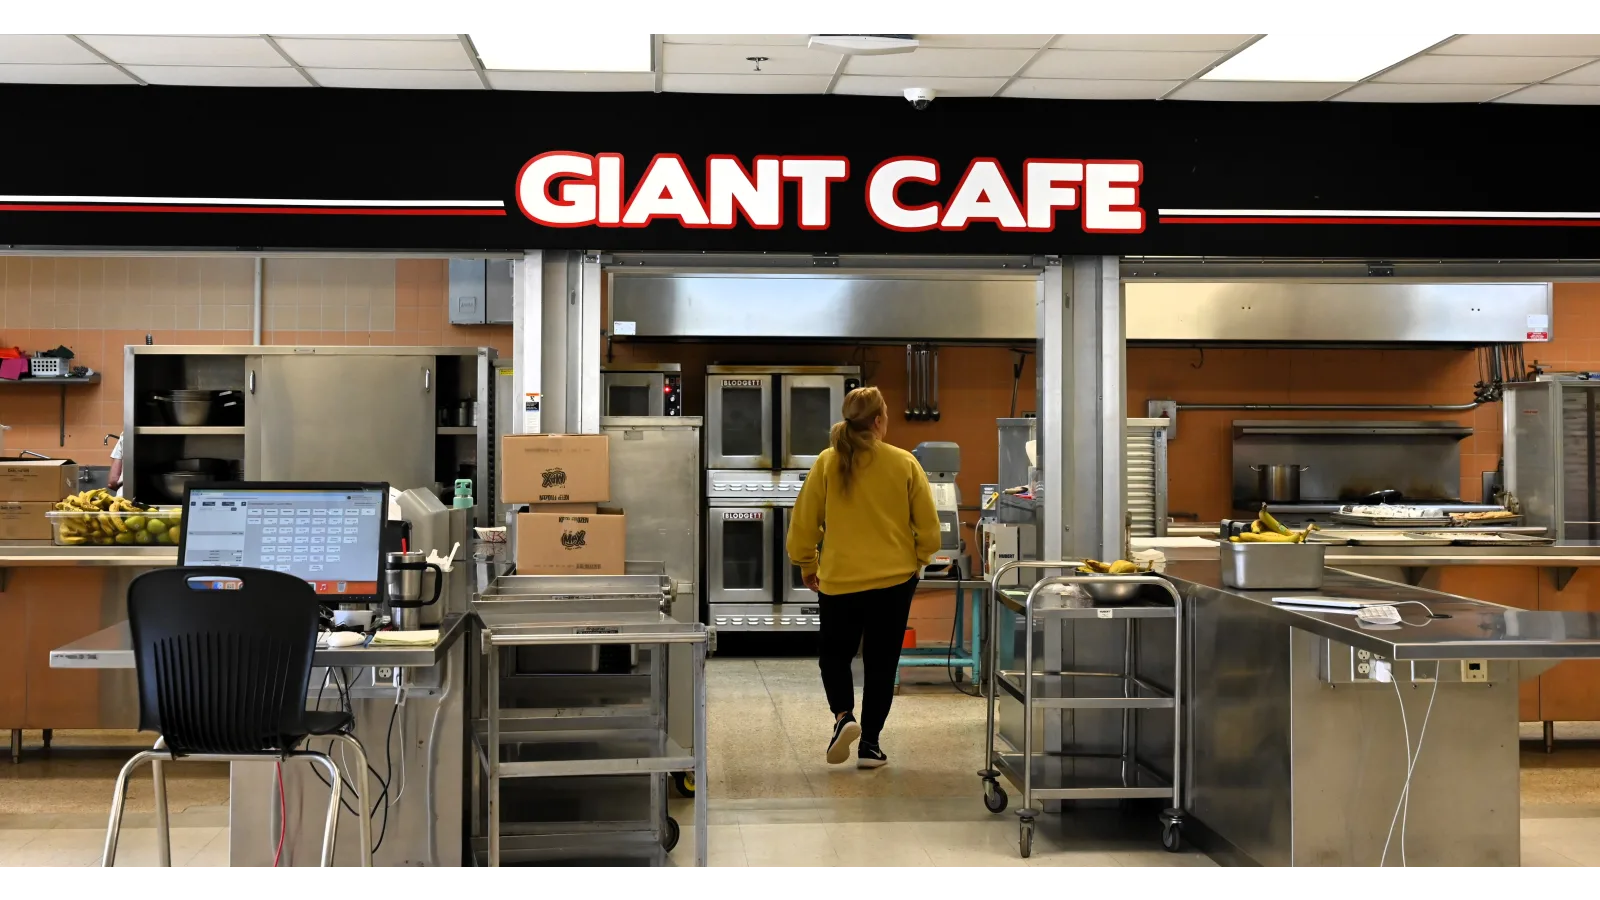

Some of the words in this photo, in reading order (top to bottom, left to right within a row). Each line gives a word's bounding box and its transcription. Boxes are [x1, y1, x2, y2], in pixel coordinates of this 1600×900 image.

[515, 151, 849, 230] GIANT
[866, 157, 1146, 234] CAFE
[723, 379, 760, 387] BLODGETT
